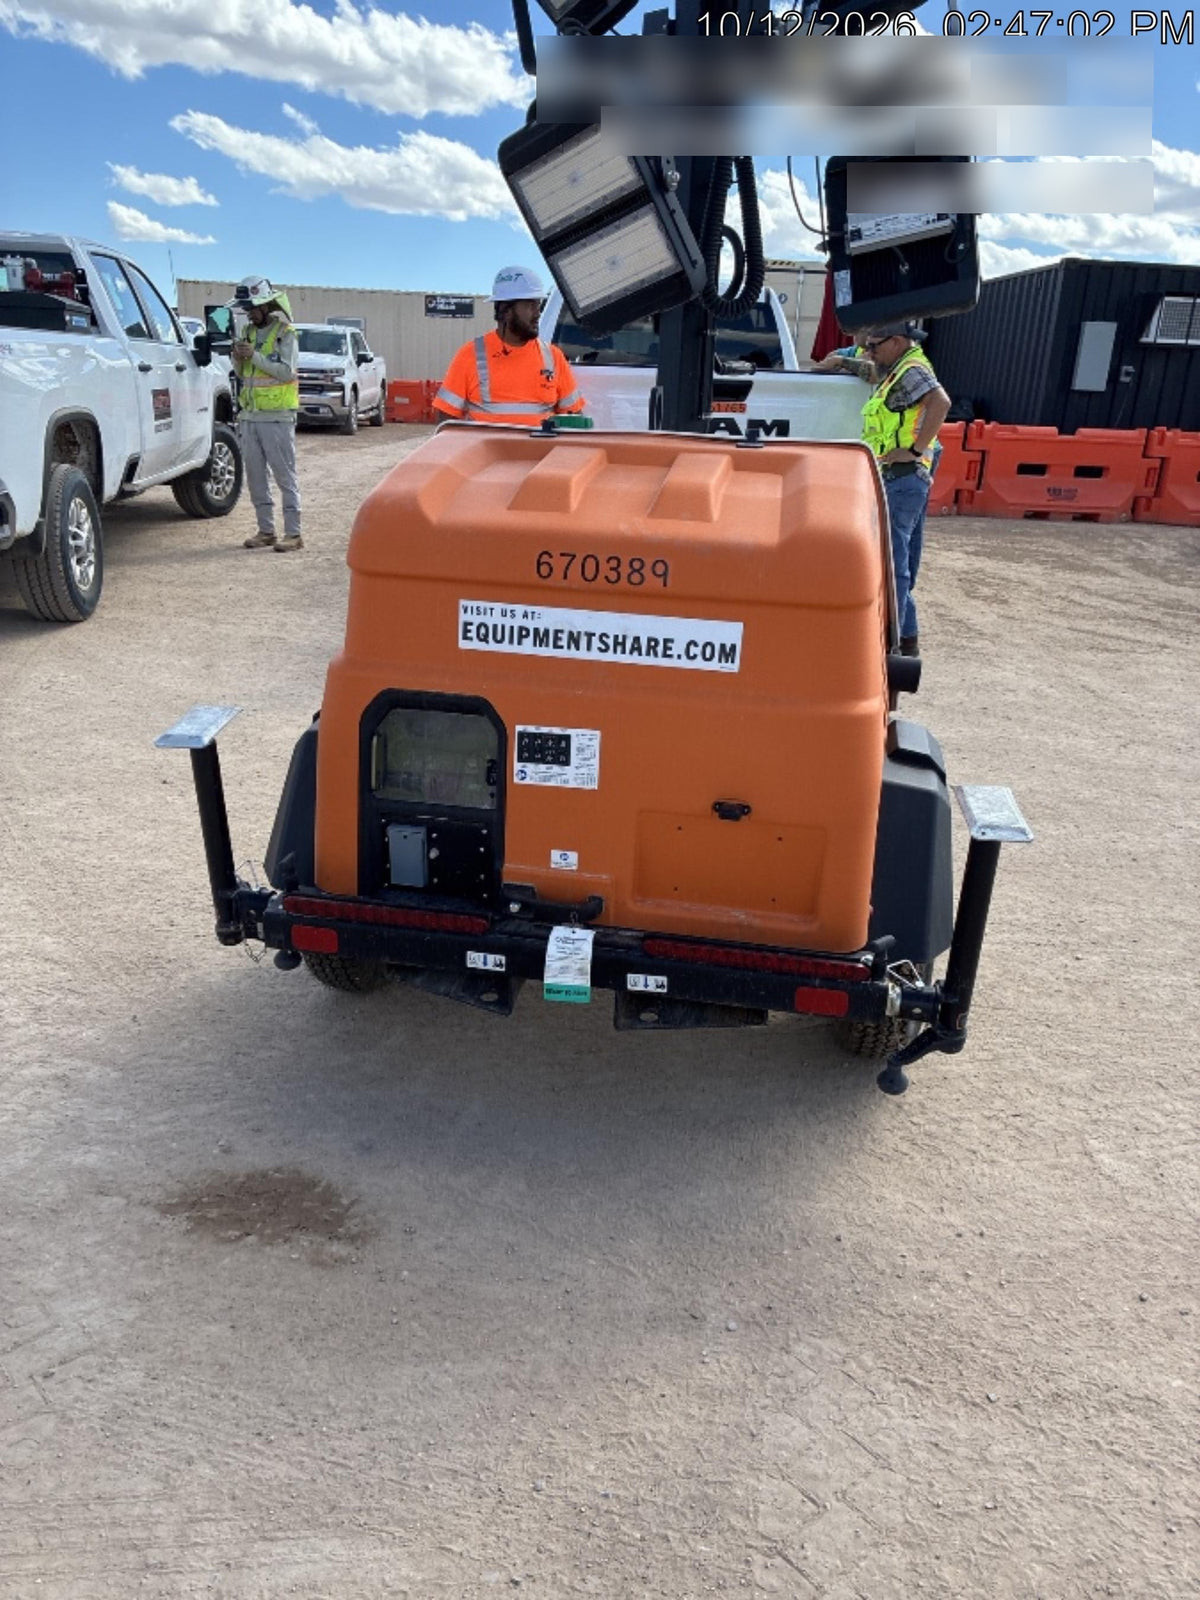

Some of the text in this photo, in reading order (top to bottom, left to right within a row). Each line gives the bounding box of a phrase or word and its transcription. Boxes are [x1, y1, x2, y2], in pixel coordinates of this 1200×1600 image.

[711, 402, 746, 413] 1765
[708, 417, 790, 437] AM
[536, 550, 669, 588] 670389
[461, 604, 542, 621] VISIT US AT:
[461, 620, 737, 664] EQUIPMENTSHARE.COM
